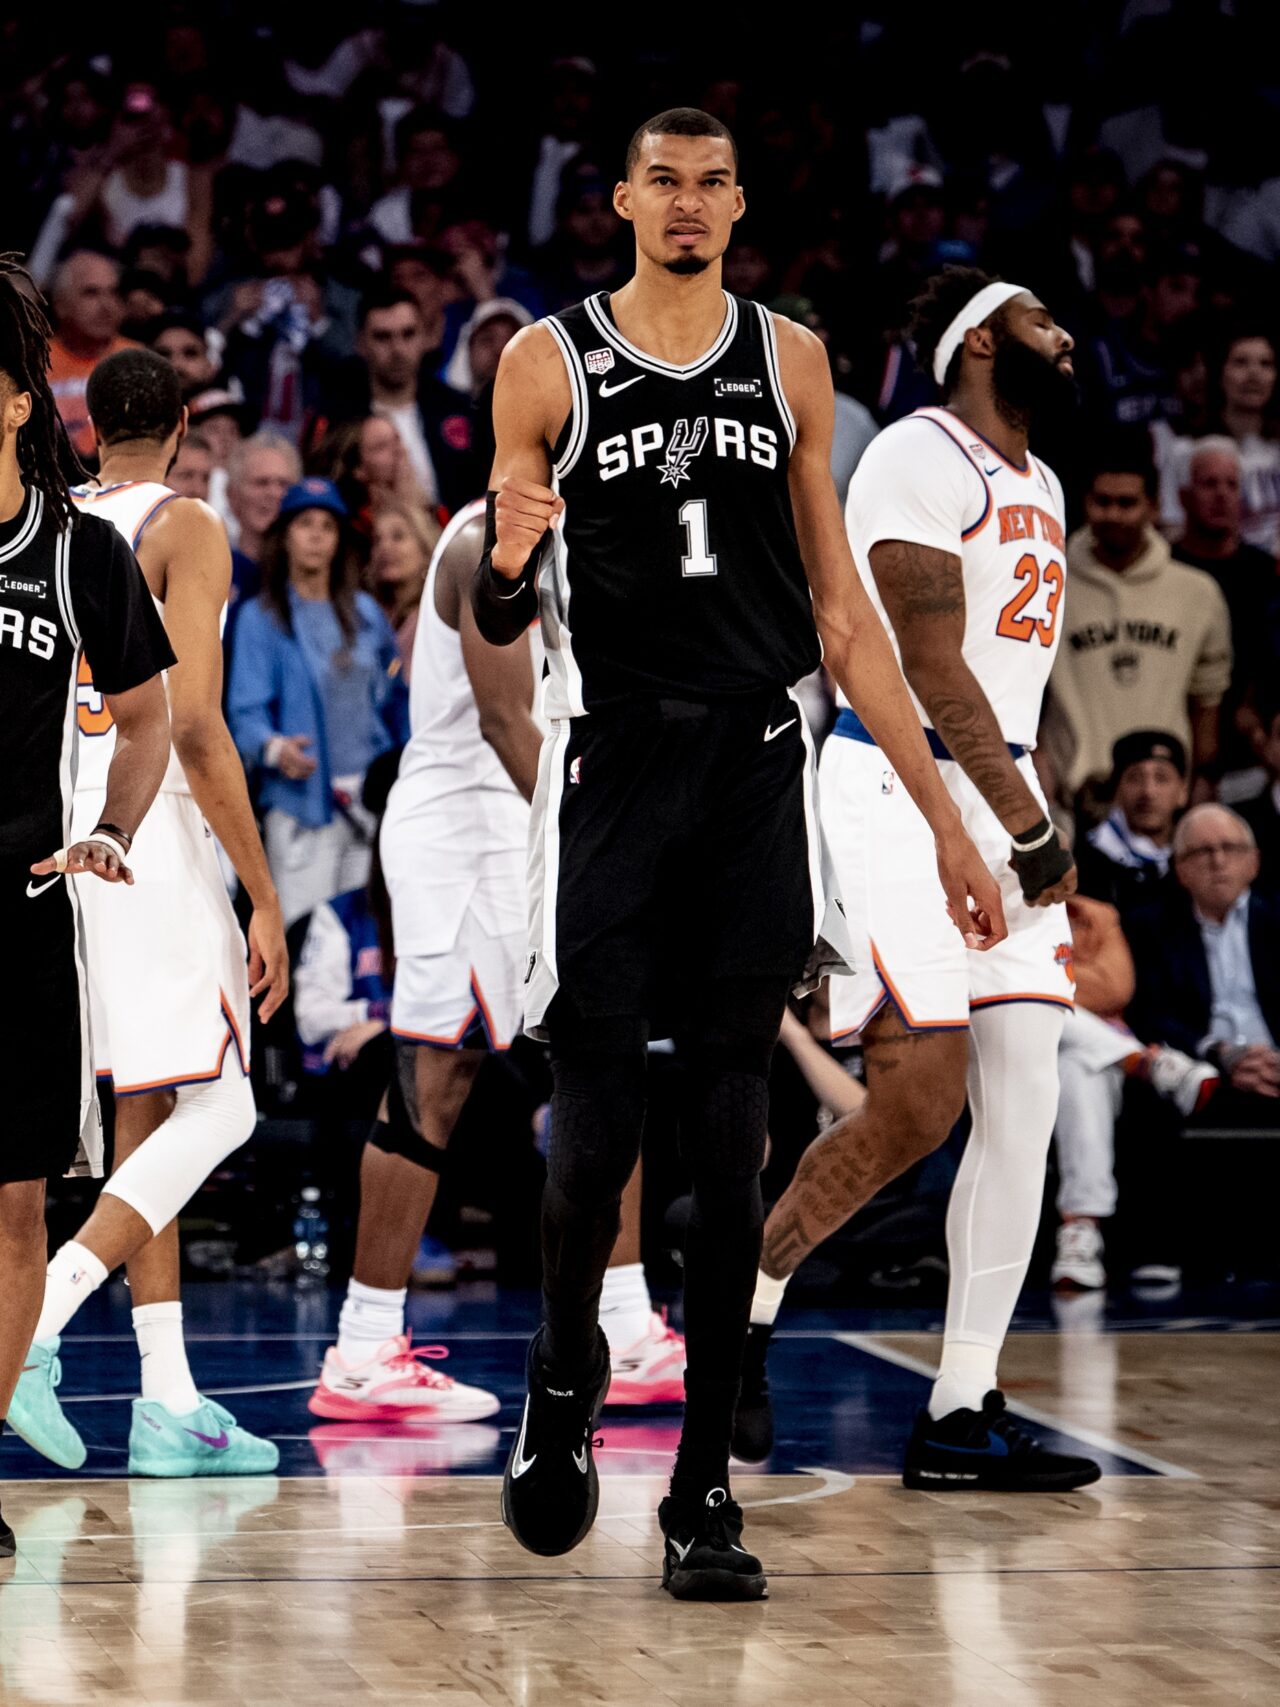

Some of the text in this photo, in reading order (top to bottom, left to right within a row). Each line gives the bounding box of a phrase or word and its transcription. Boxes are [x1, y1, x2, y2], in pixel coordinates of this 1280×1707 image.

[720, 383, 756, 393] LEDGER
[596, 416, 778, 489] SPURS
[677, 499, 718, 577] 1
[4, 580, 41, 593] LEDGER
[996, 553, 1064, 649] 23
